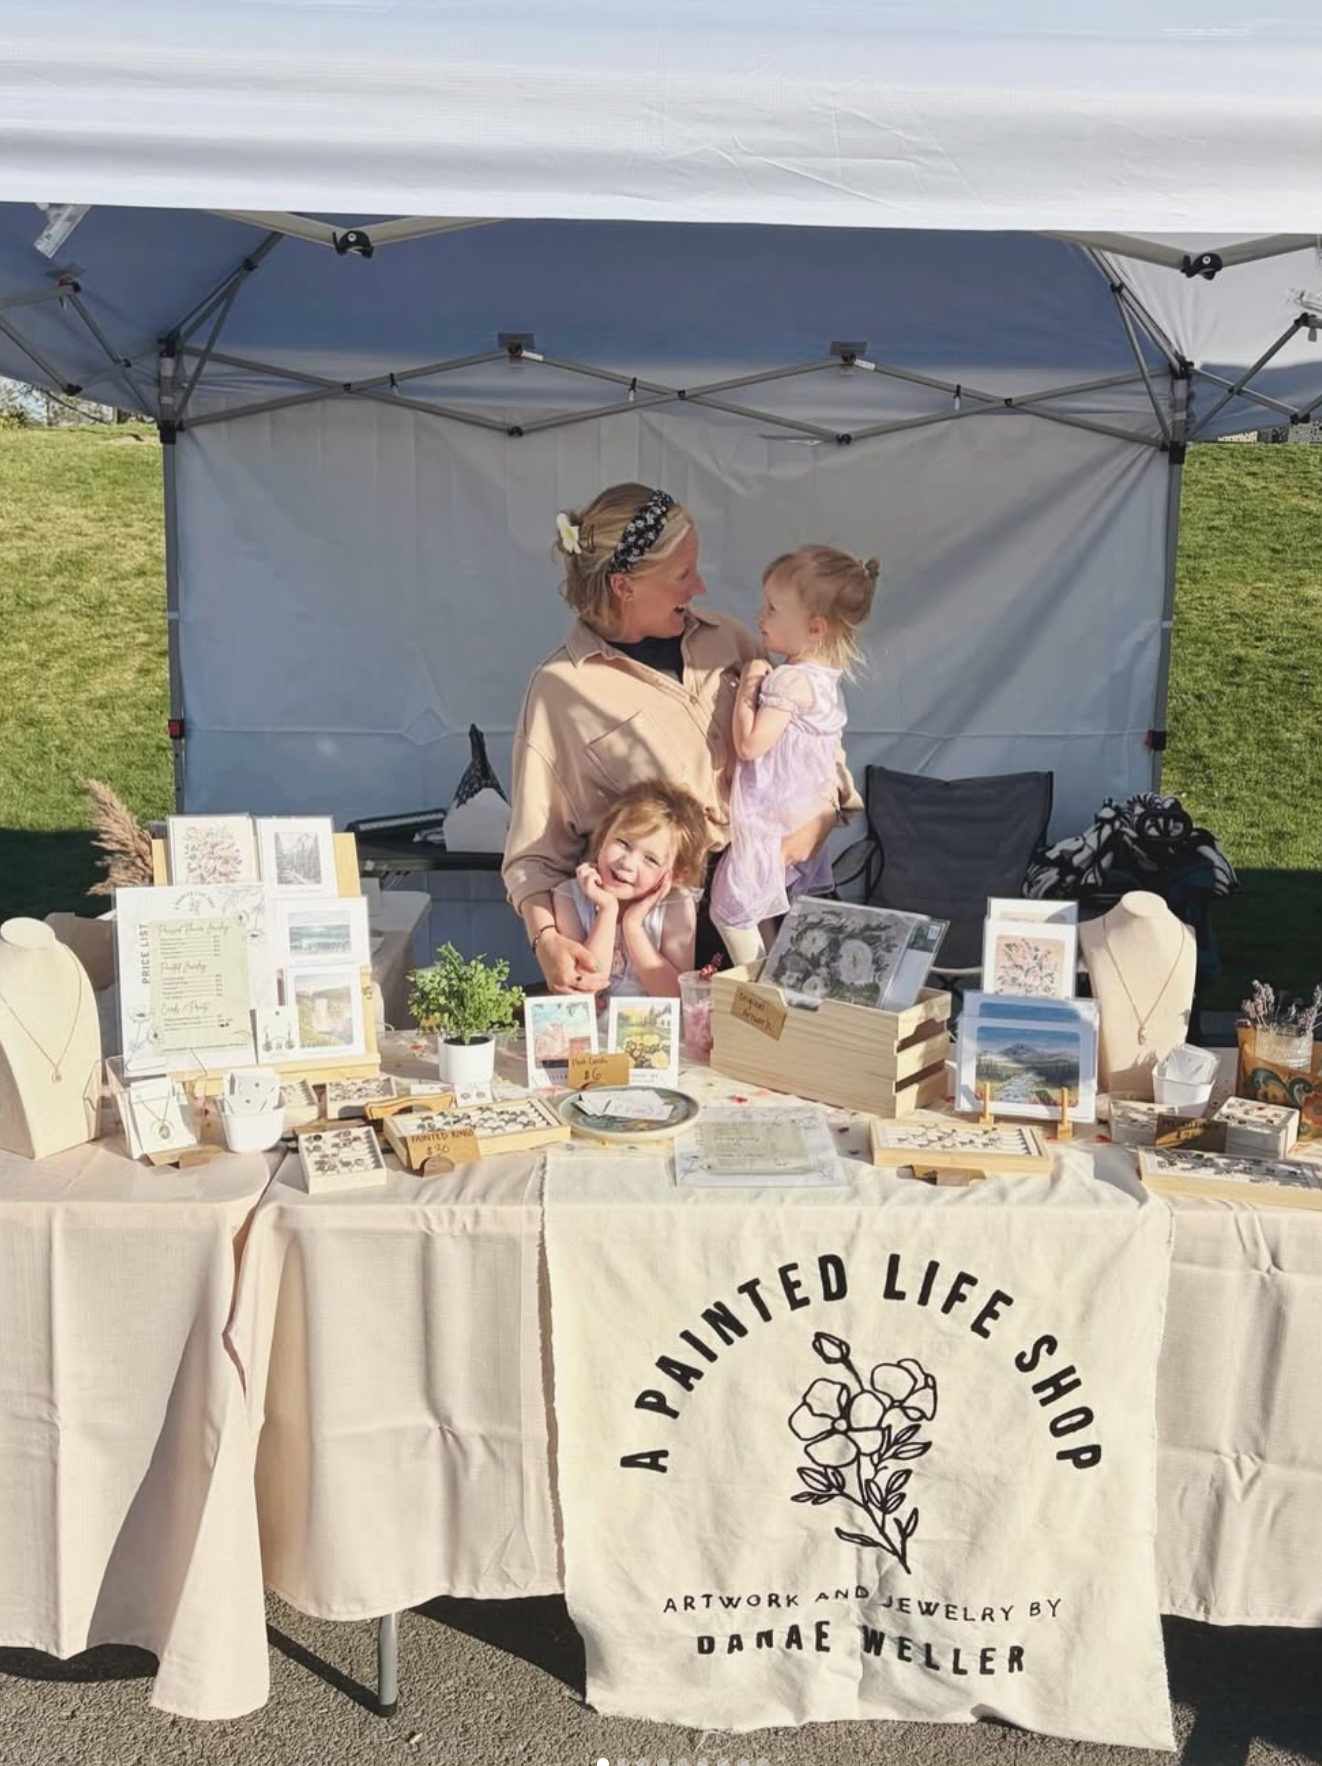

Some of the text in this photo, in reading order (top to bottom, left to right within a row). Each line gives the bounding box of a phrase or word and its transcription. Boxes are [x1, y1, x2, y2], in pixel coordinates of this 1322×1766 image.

[138, 923, 151, 985] PRICE LIST
[410, 1130, 448, 1144] PAINTED
[620, 1252, 1103, 1474] A PAINTED LIFE SHOP
[663, 1584, 1062, 1622] ARTWORK AND JEWELRY BY
[697, 1620, 1025, 1675] DANAE WELLER
